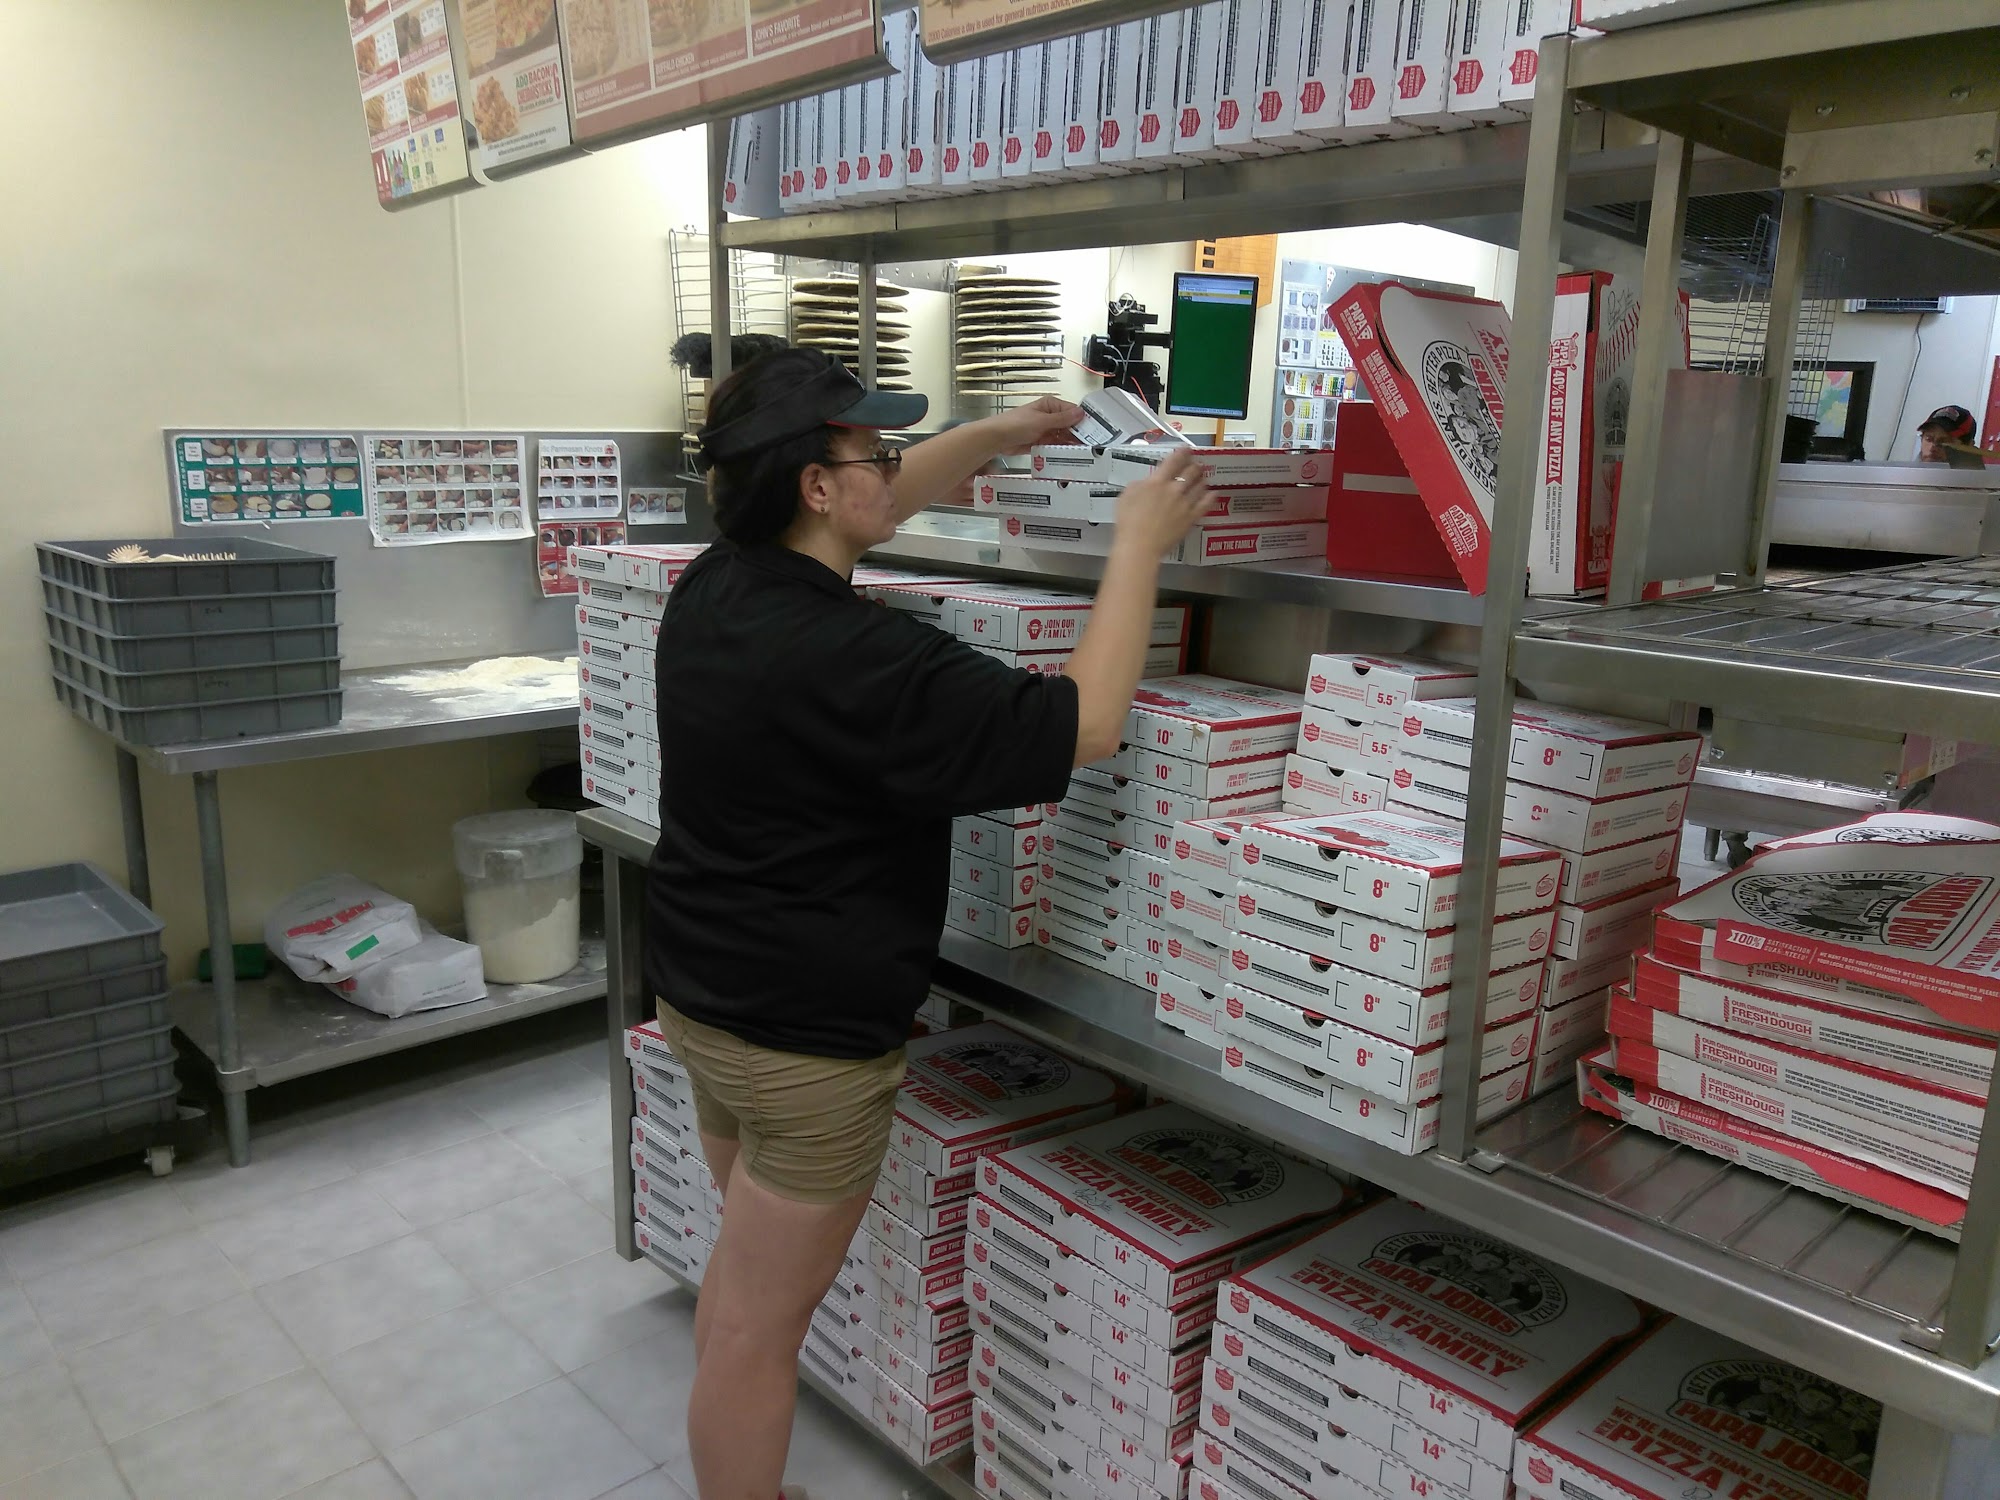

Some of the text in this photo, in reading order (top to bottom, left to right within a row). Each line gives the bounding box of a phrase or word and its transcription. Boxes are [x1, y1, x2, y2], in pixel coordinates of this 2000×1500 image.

[942, 3, 1050, 39] Calories day used general nutrition
[1464, 62, 1472, 92] DELIVERY
[1520, 52, 1528, 83] DELIVERY
[1348, 301, 1368, 331] PAPA
[1560, 340, 1570, 366] PAPA
[1378, 364, 1391, 382] FREE
[1426, 351, 1440, 396] BETTER
[1552, 370, 1566, 395] 40%
[1384, 378, 1400, 398] PIZZA
[1551, 399, 1564, 418] OFF
[1550, 422, 1562, 444] ANY
[1548, 445, 1562, 478] PIZZA
[1440, 514, 1454, 538] BETTER
[1450, 506, 1468, 527] PAPA
[1208, 538, 1256, 552] JOIN THE FAMILY
[973, 618, 987, 633] 12"
[1044, 618, 1074, 628] JOIN OUR
[1044, 628, 1074, 638] FAMILY!
[1042, 664, 1057, 672] JOIN
[1377, 692, 1398, 706] 5.5"
[1157, 728, 1174, 745] 10"
[1372, 742, 1392, 754] 5.5"
[1543, 747, 1562, 766] 8"
[1156, 764, 1172, 780] 10"
[1352, 790, 1372, 804] 5.5"
[1156, 800, 1172, 816] 10"
[1154, 833, 1171, 850] 10"
[1372, 879, 1390, 898] 8"
[1777, 872, 1854, 887] BETTER
[1732, 930, 1762, 948] 100%
[1887, 916, 1952, 949] PAPA
[1370, 933, 1386, 952] 8"
[1756, 970, 1780, 980] STORY
[1830, 960, 1983, 1002] LOCAL RESTAURANT MANAGER VISIT PAPAJOHNS.COM
[1855, 958, 1868, 968] YOUR
[1868, 961, 1882, 971] PIZZA
[1948, 980, 1962, 990] FROM
[1364, 994, 1380, 1013] 8"
[1732, 1000, 1782, 1019] OUR ORIGINAL
[1732, 1006, 1812, 1035] FRESH DOUGH
[1732, 1016, 1756, 1026] STORY
[1702, 1037, 1749, 1058] OUR ORIGINAL
[1356, 1048, 1374, 1067] 8"
[1702, 1053, 1724, 1065] STORY
[1702, 1044, 1778, 1076] FRESH DOUGH
[1708, 1078, 1756, 1098] OUR ORIGINAL
[906, 1086, 977, 1122] FAMILY
[1360, 1098, 1376, 1118] 8"
[1652, 1094, 1678, 1113] 100%
[1708, 1093, 1730, 1104] STORY
[1708, 1084, 1784, 1117] FRESH DOUGH
[1134, 1132, 1174, 1146] BETTER
[1666, 1124, 1740, 1156] FRESH DOUGH
[952, 1149, 982, 1164] JOIN THE
[1114, 1146, 1170, 1176] PAPA
[937, 1182, 954, 1192] JOIN
[1049, 1154, 1114, 1192] PIZZA
[1107, 1188, 1202, 1237] FAMILY
[931, 1244, 948, 1256] JOIN
[1380, 1234, 1420, 1256] BETTER
[1115, 1246, 1130, 1264] 14"
[1176, 1264, 1230, 1291] JOIN THE FAMILY
[1365, 1257, 1428, 1288] PAPA
[928, 1279, 944, 1291] JOIN
[1114, 1289, 1130, 1308] 14"
[1178, 1321, 1194, 1332] JOIN
[1300, 1272, 1393, 1322] PIZZA
[1390, 1314, 1520, 1378] FAMILY
[1112, 1326, 1128, 1344] 14"
[1422, 1311, 1460, 1336] PIZZA
[1458, 1328, 1528, 1370] COMPANY.
[1114, 1366, 1130, 1386] 14"
[1687, 1366, 1730, 1396] BETTER
[1112, 1396, 1128, 1414] 14"
[1430, 1392, 1453, 1415] 14"
[1676, 1400, 1766, 1451] PAPA
[1122, 1438, 1138, 1458] 14"
[1423, 1437, 1446, 1460] 14"
[1607, 1423, 1724, 1492] PIZZA
[1106, 1464, 1122, 1483] 14"
[1410, 1474, 1433, 1497] 14"
